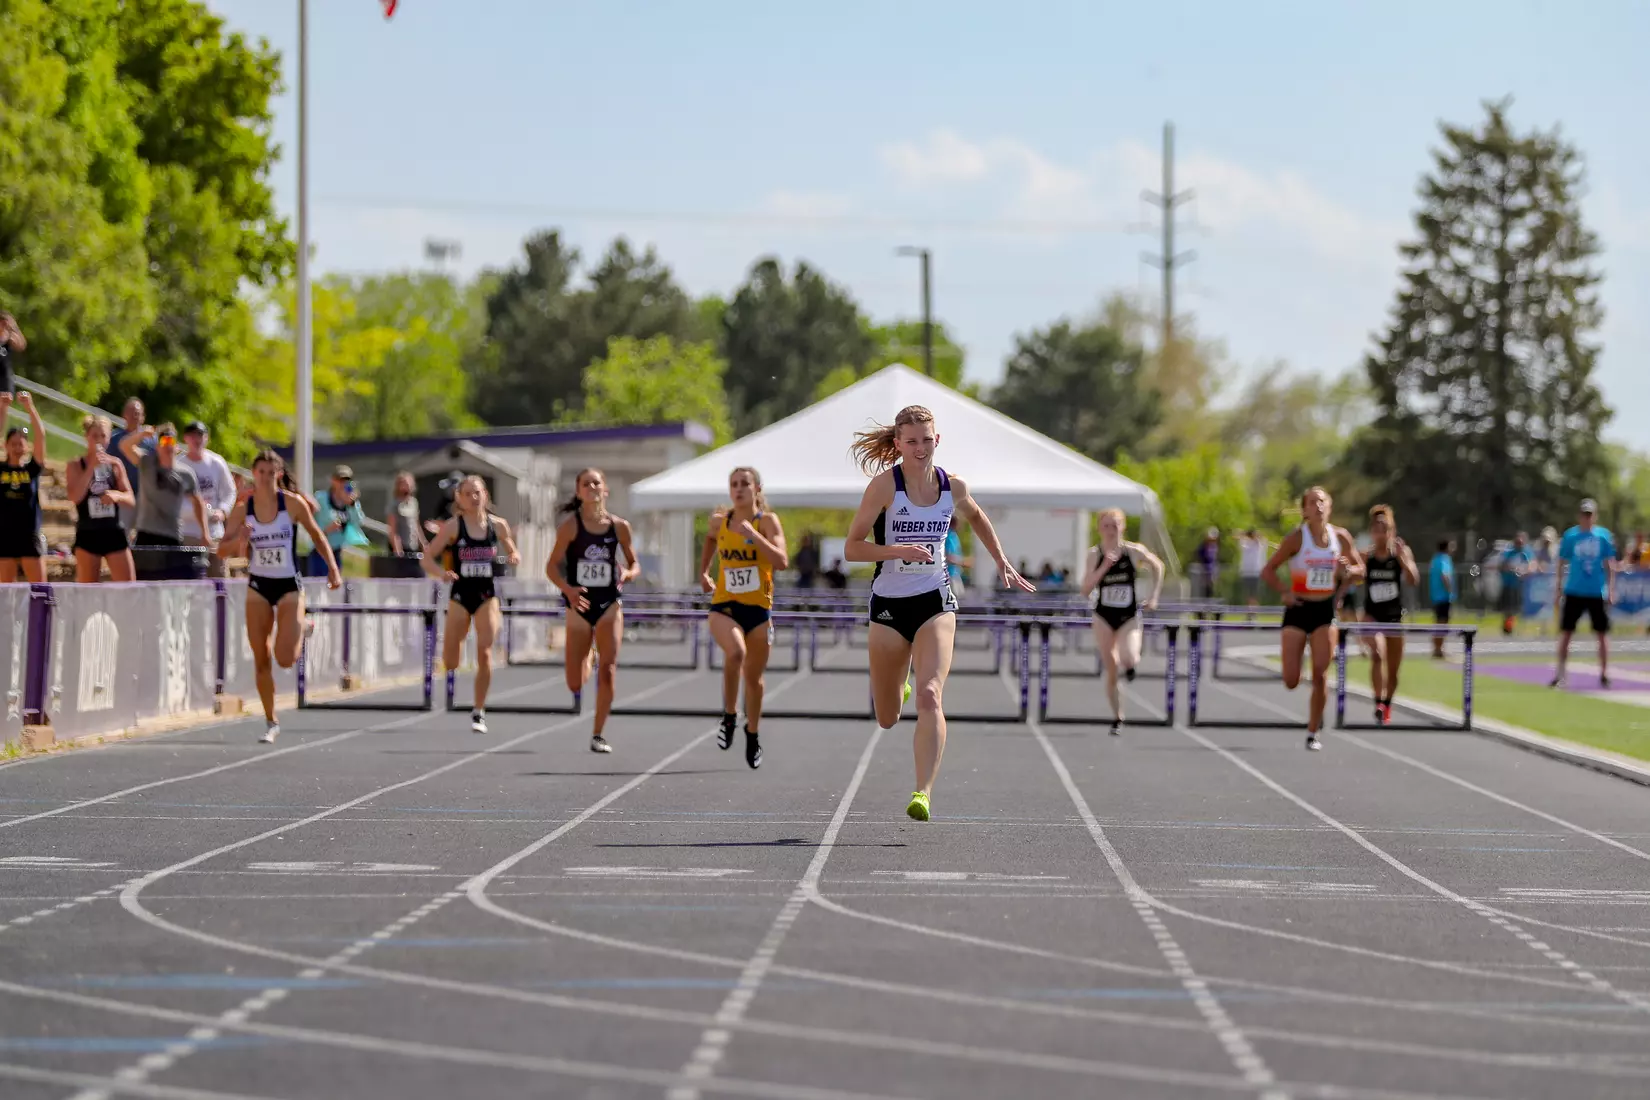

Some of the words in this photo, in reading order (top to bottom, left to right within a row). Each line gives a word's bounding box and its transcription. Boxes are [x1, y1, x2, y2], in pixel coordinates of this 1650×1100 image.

[892, 520, 925, 533] WEBER
[260, 549, 282, 565] 524
[582, 564, 606, 579] 264
[729, 569, 752, 587] 357
